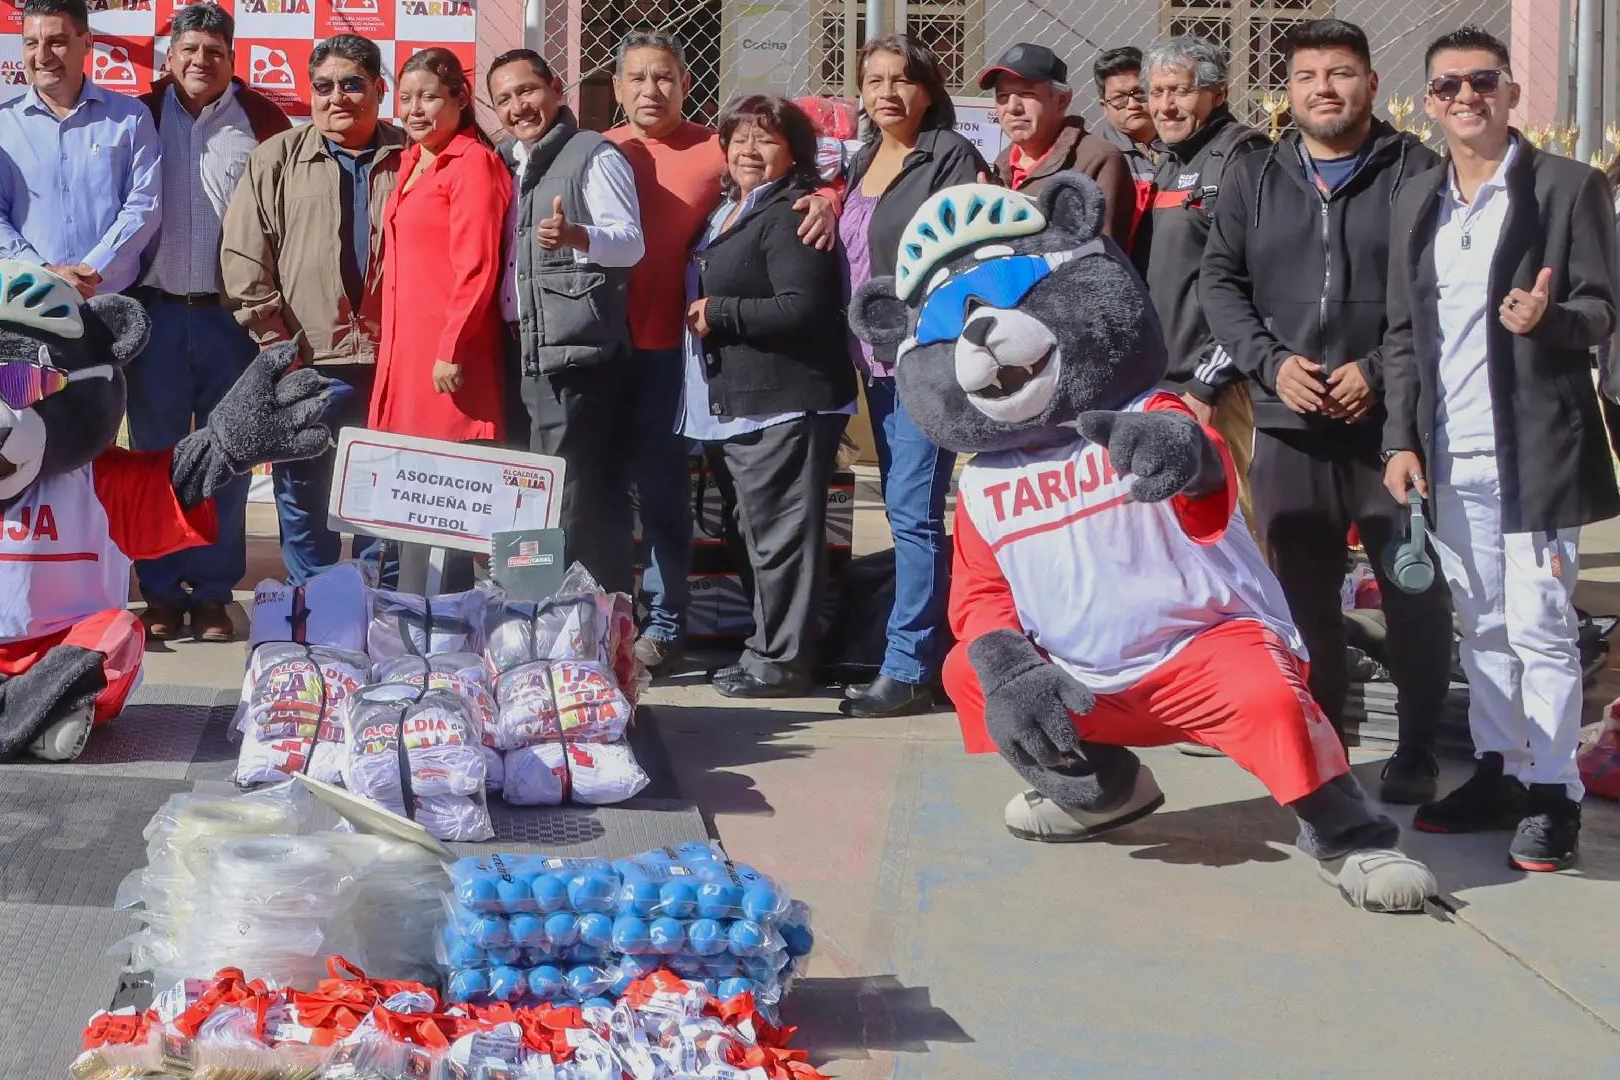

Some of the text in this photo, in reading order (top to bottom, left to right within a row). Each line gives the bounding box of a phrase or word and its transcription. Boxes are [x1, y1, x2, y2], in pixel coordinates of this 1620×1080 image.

[241, 0, 310, 14] TARIJA
[402, 1, 473, 16] TARIJA
[742, 39, 788, 50] Cocina
[396, 469, 492, 494] ASOCIACION
[391, 488, 492, 515] TARIJEÑA DE
[407, 512, 469, 532] FUTBOL
